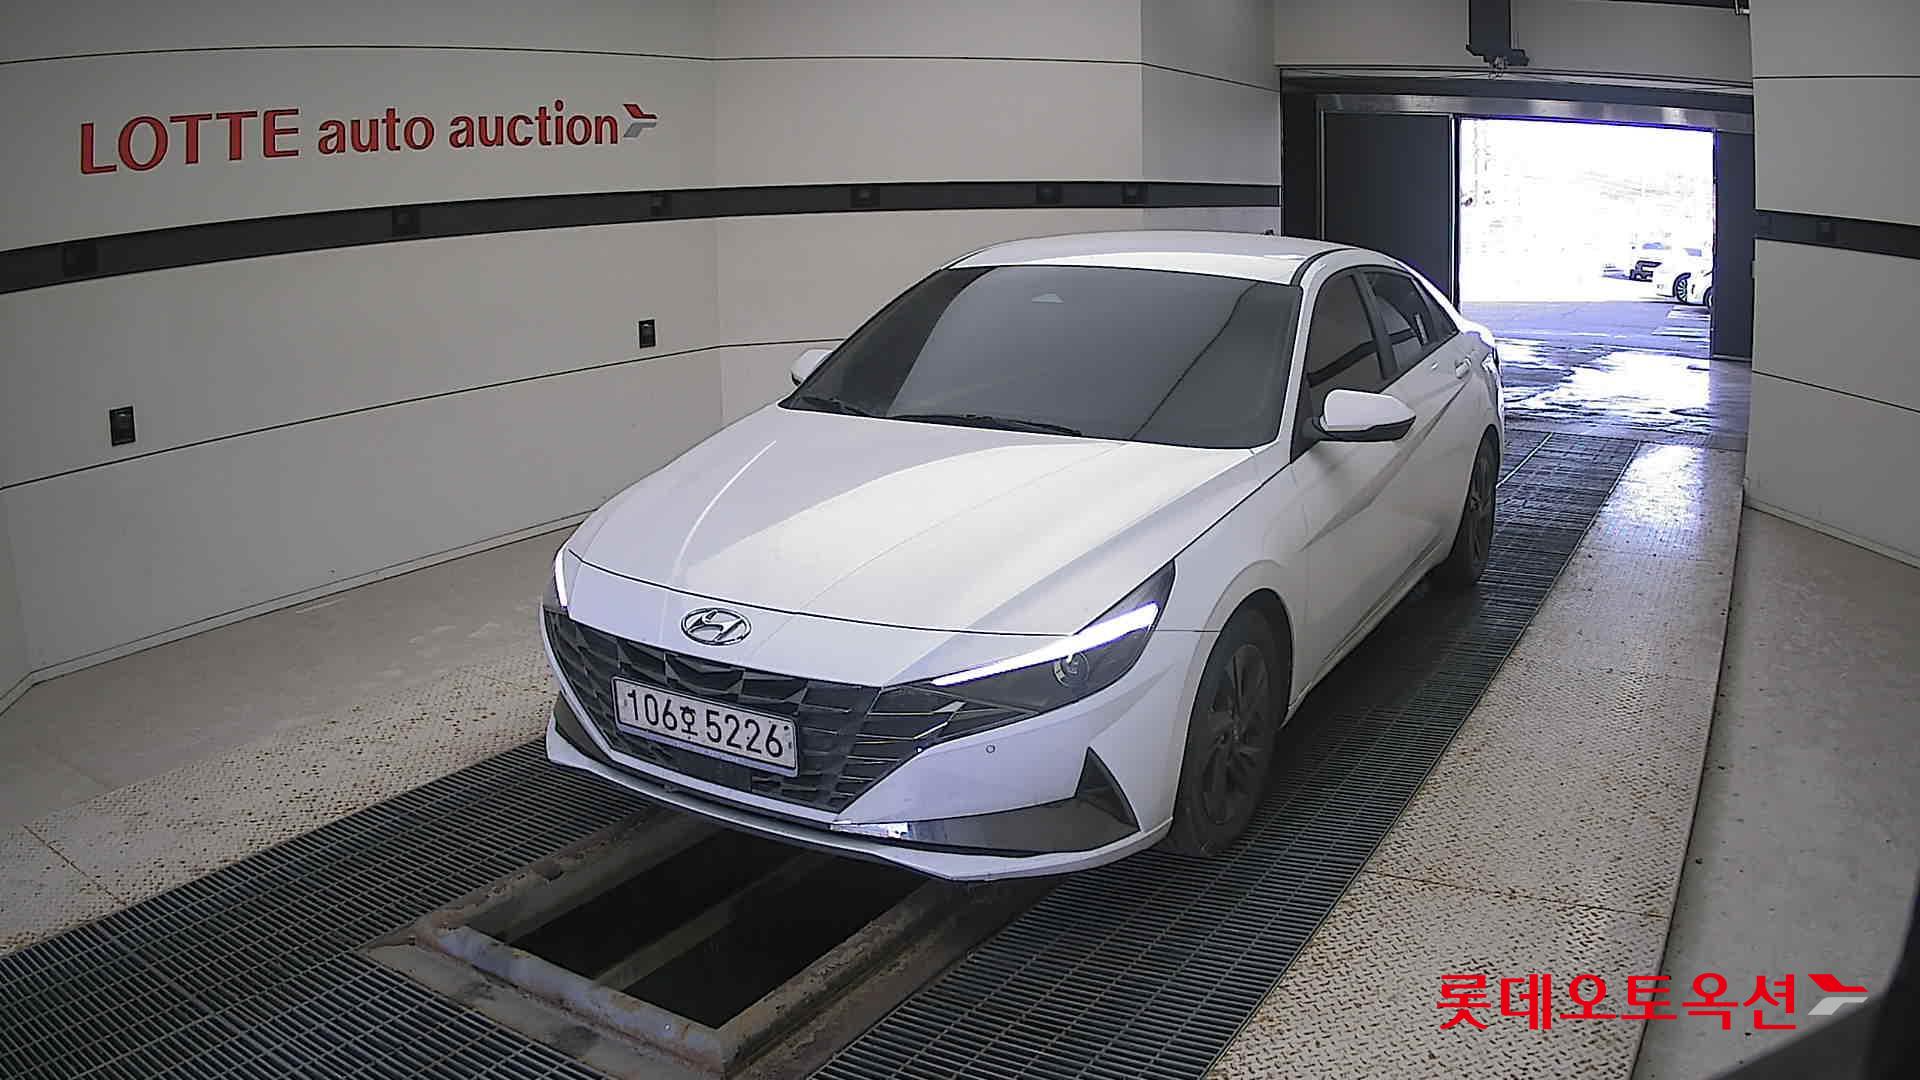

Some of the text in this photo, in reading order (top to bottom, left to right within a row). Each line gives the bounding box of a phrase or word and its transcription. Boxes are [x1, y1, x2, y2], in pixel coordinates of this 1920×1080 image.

[80, 99, 619, 175] LOTTE auto auction
[627, 689, 784, 758] 106호 5226
